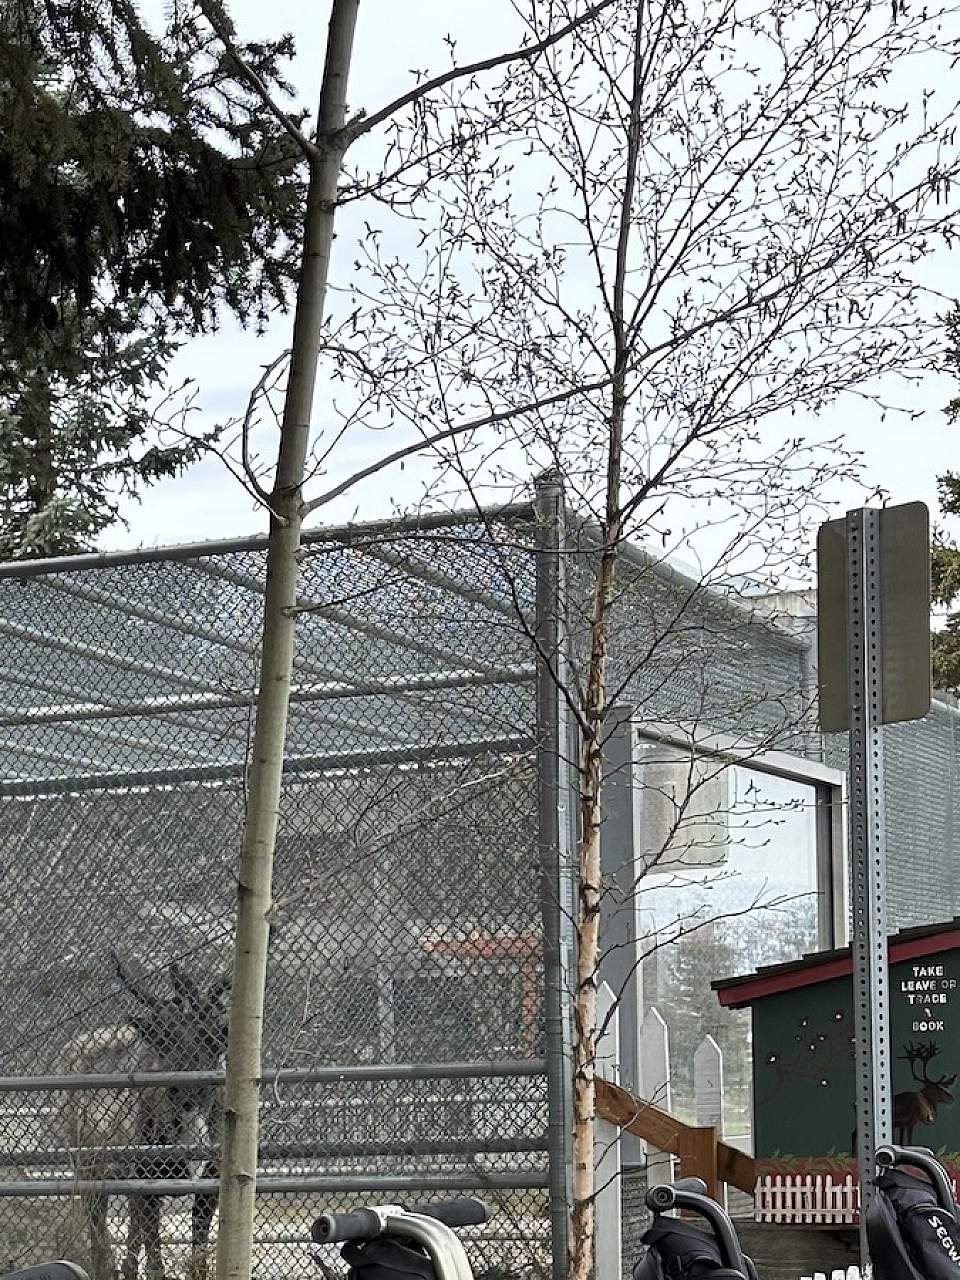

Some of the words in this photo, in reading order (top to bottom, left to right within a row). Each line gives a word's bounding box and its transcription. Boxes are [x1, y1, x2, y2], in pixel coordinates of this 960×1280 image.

[912, 966, 943, 977] TAKE
[901, 980, 936, 991] LEAVE
[941, 979, 956, 989] OR
[908, 993, 946, 1004] TRADE
[912, 1020, 944, 1031] BOOK
[928, 1215, 960, 1266] SEGW
